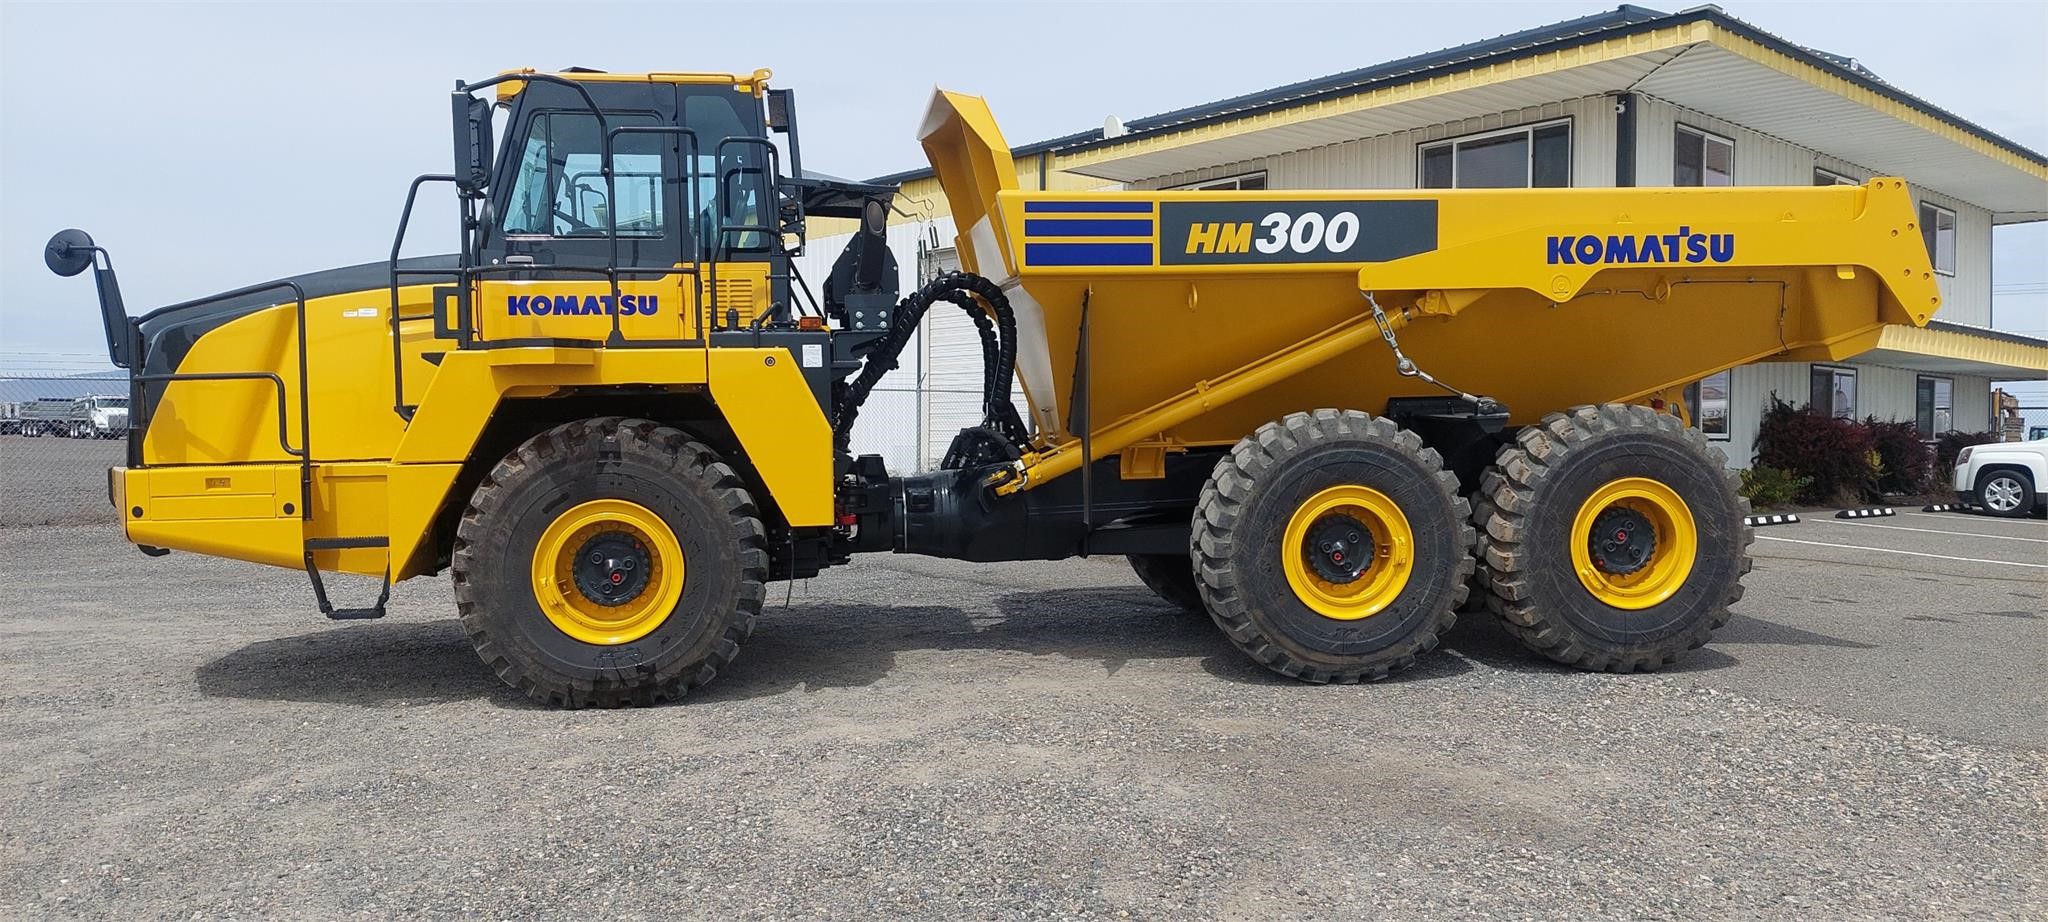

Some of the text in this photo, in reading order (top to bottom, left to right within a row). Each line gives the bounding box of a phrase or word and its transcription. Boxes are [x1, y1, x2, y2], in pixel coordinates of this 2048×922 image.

[1185, 211, 1360, 254] HM300
[1547, 226, 1734, 264] KOMATSU
[508, 289, 658, 316] KOMATSU
